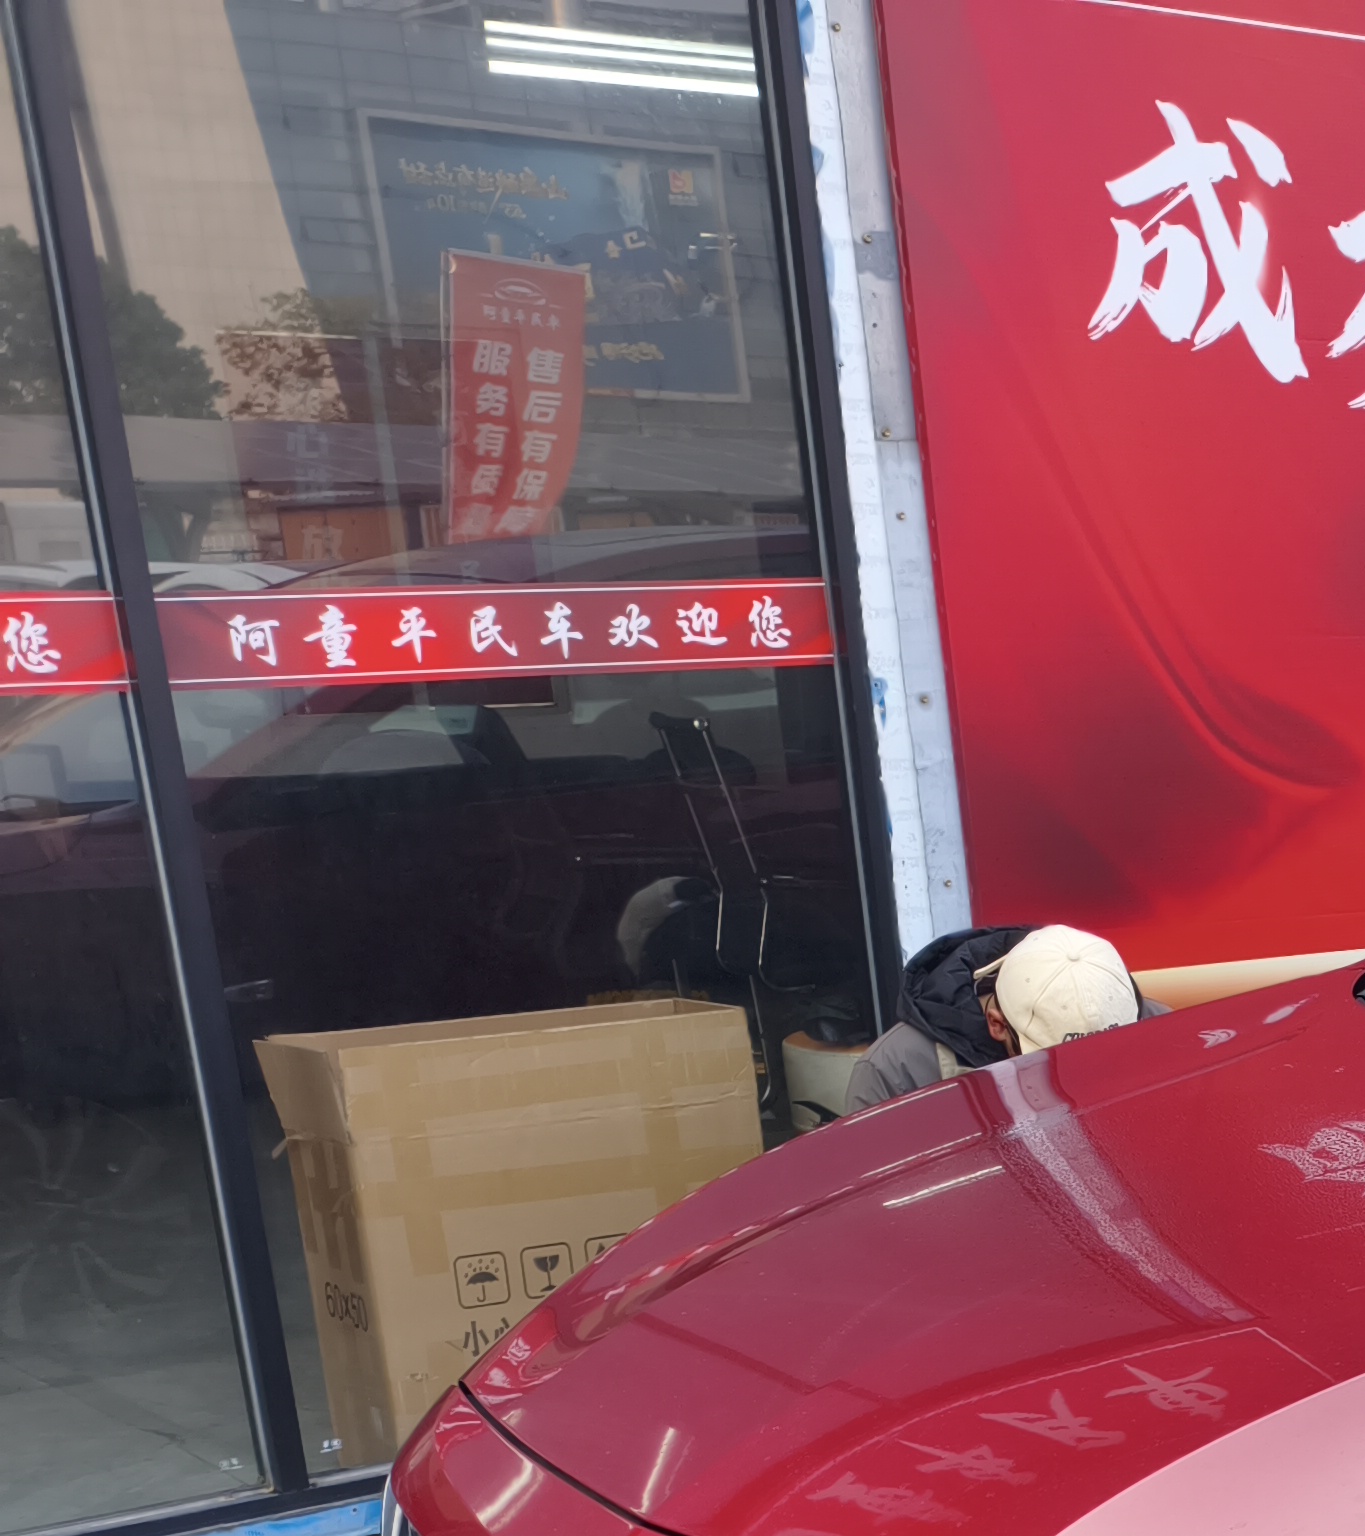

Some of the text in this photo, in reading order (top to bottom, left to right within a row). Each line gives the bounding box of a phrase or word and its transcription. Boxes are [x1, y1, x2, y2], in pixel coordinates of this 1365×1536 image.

[1, 611, 61, 674] 您
[229, 596, 792, 669] 阿童平民车欢迎您
